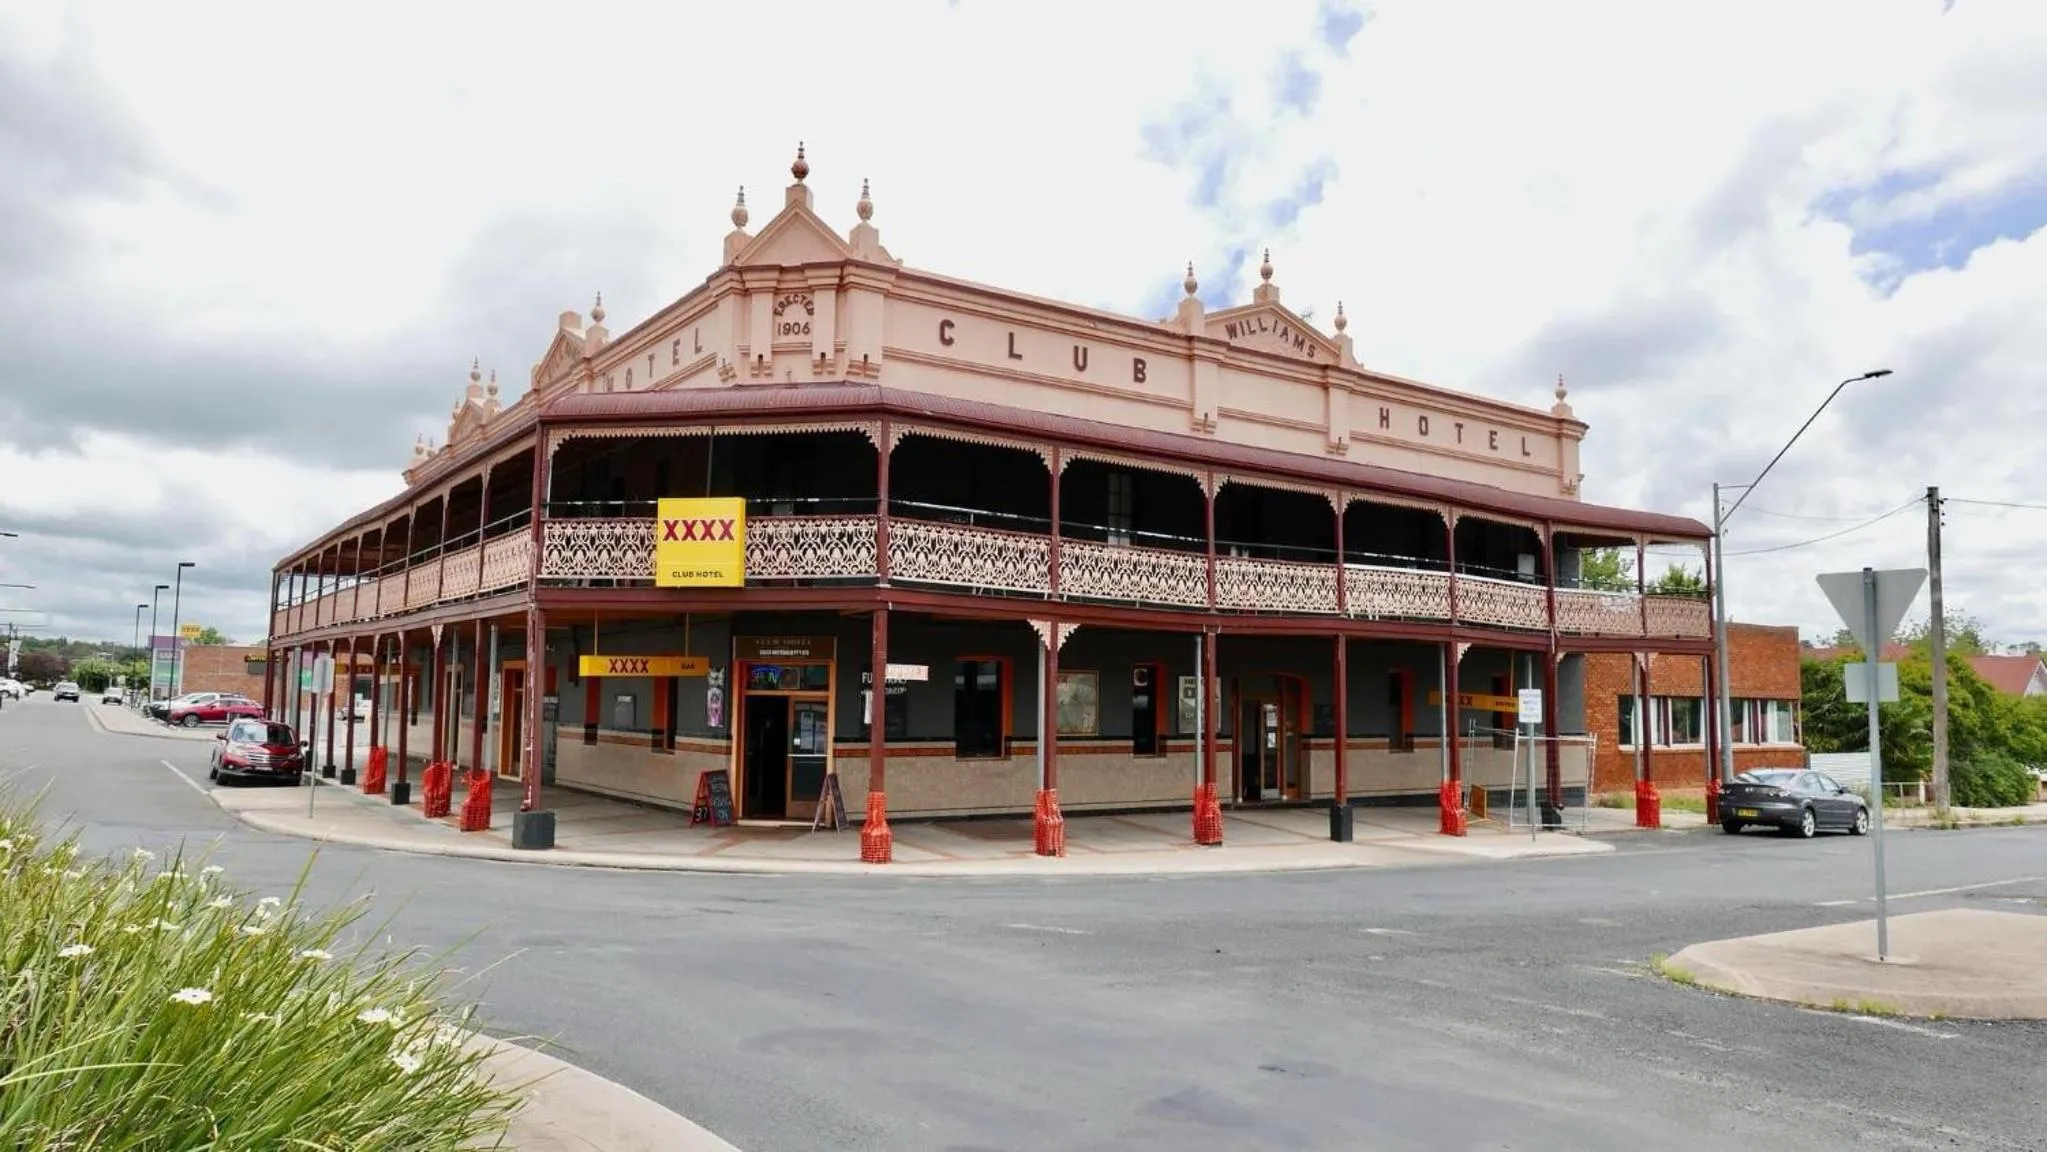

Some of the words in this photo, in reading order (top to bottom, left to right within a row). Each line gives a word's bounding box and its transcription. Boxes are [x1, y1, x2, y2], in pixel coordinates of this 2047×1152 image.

[773, 293, 815, 317] ERECTED
[777, 321, 811, 336] 1906
[1224, 317, 1316, 358] WILLIAMS
[939, 319, 1147, 384] CLUB
[1379, 406, 1531, 457] HOTEL
[662, 519, 736, 541] XXXX
[609, 658, 649, 674] XXXX
